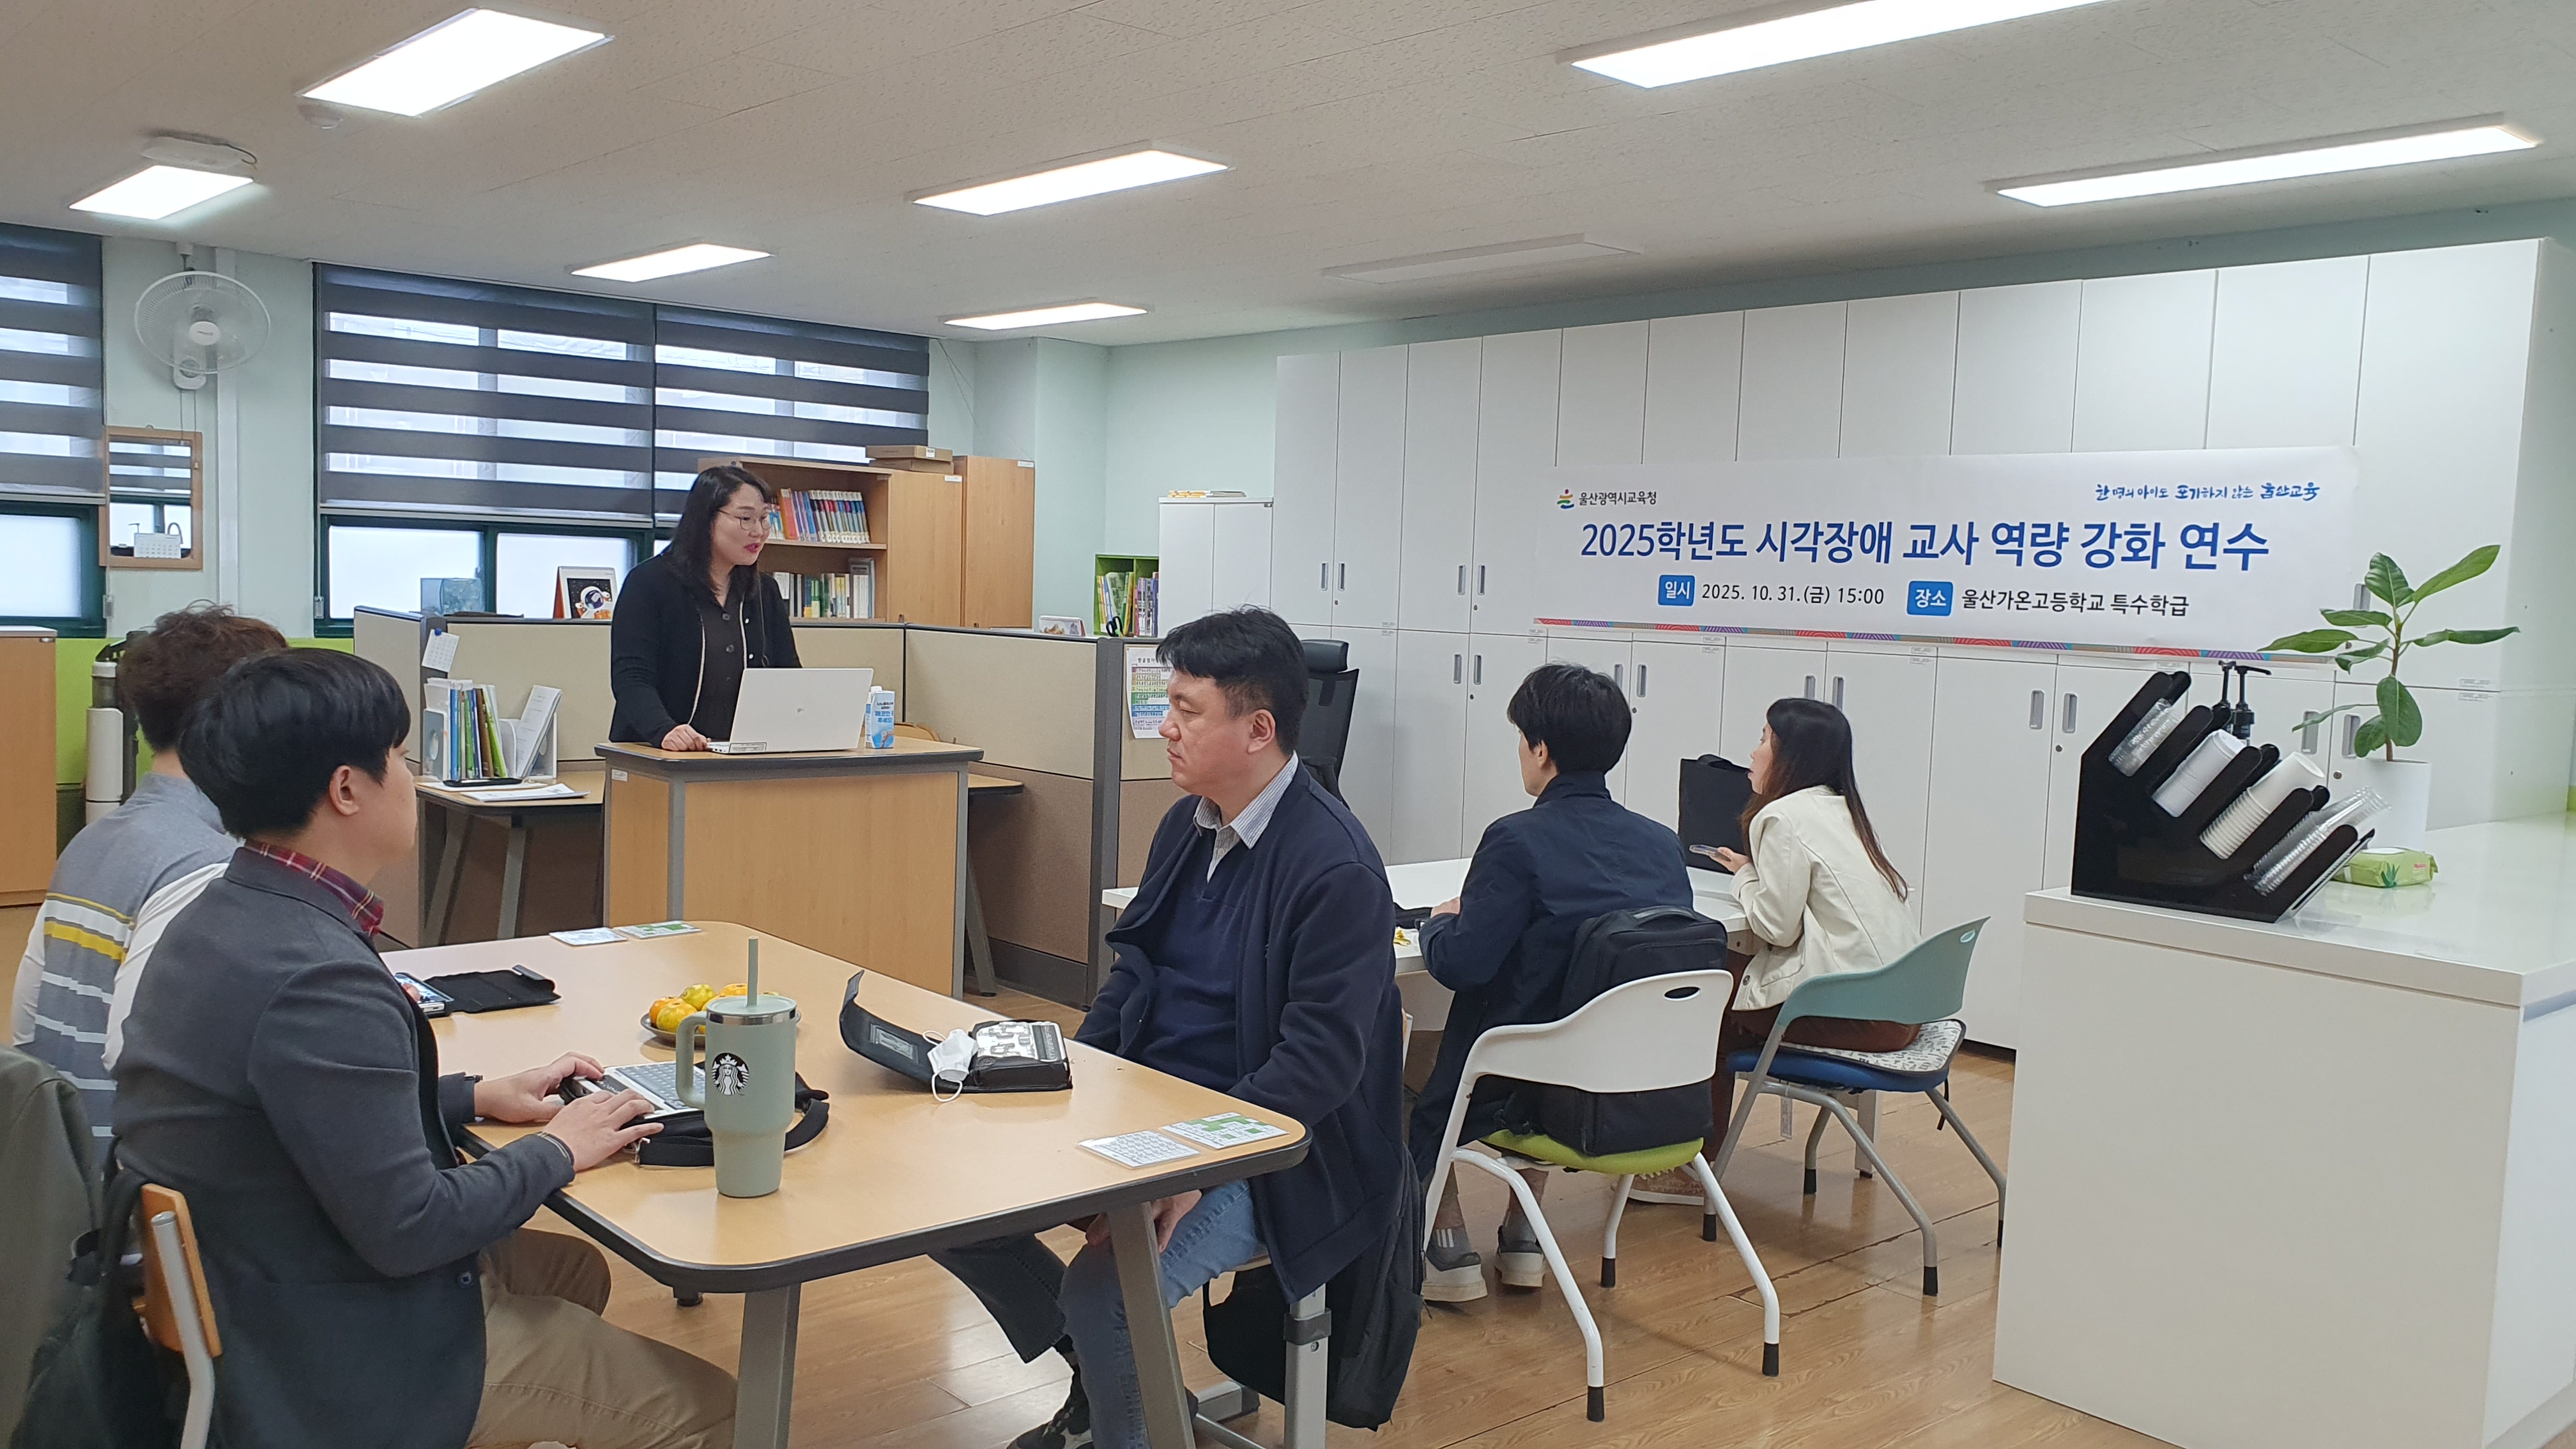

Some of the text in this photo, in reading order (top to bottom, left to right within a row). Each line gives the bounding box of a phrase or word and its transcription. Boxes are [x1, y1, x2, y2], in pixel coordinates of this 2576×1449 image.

[1579, 491, 1656, 505] 울산광역시교육청
[2138, 485, 2168, 499] 아이도
[2175, 485, 2227, 500] 포기하지
[2232, 485, 2253, 498] 않는
[2260, 482, 2320, 501] 울산교육
[1581, 521, 2269, 571] 2025학년도 시각장애 교사 역량 강화 연수
[1665, 581, 1690, 599] 일시
[1702, 585, 1744, 599] 2025.
[1753, 586, 1772, 601] 10.
[1839, 588, 1883, 604] 15:00
[1915, 589, 2189, 616] 장소 울산가온고등학교 특수학급
